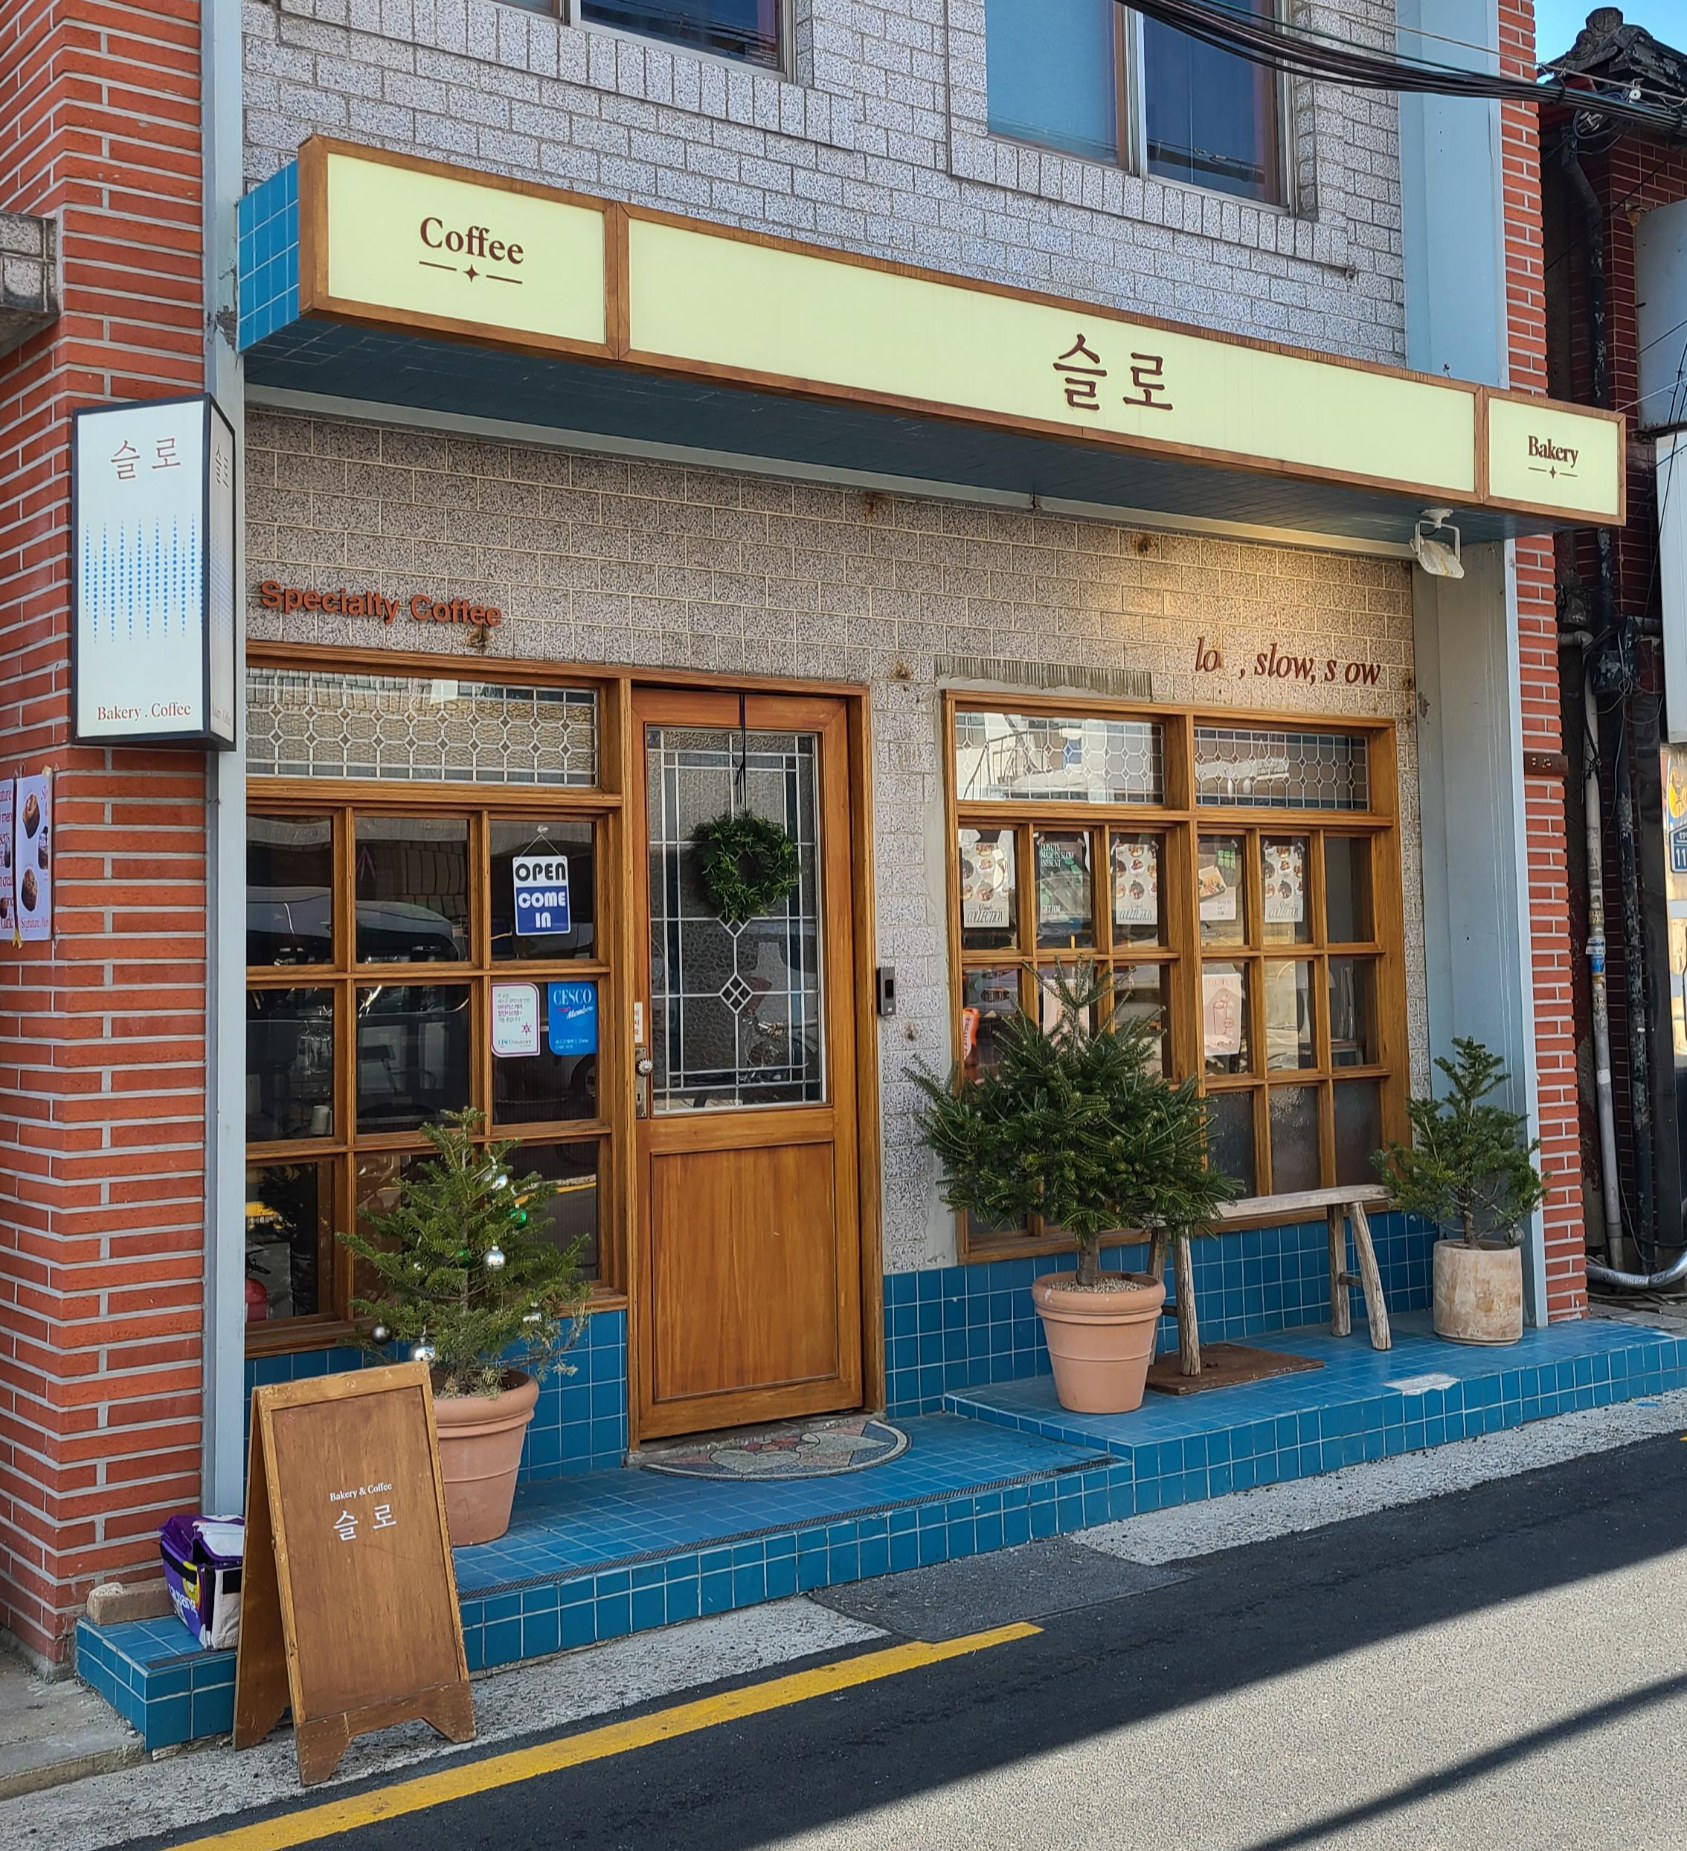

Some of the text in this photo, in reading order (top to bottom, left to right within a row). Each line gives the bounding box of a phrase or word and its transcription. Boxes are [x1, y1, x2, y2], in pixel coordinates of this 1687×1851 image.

[420, 217, 524, 265] Coffee
[1053, 333, 1174, 411] 슬로
[110, 438, 181, 480] 슬로
[1528, 435, 1579, 469] Bakery
[260, 580, 503, 627] Specialty Coffee
[97, 704, 141, 722] Bakery
[151, 702, 192, 718] Coffee
[515, 862, 566, 882] OPEN
[518, 891, 566, 909] COME
[535, 912, 551, 928] IN
[553, 987, 592, 1006] CESCO
[330, 1482, 393, 1502] Bakery & Coffee
